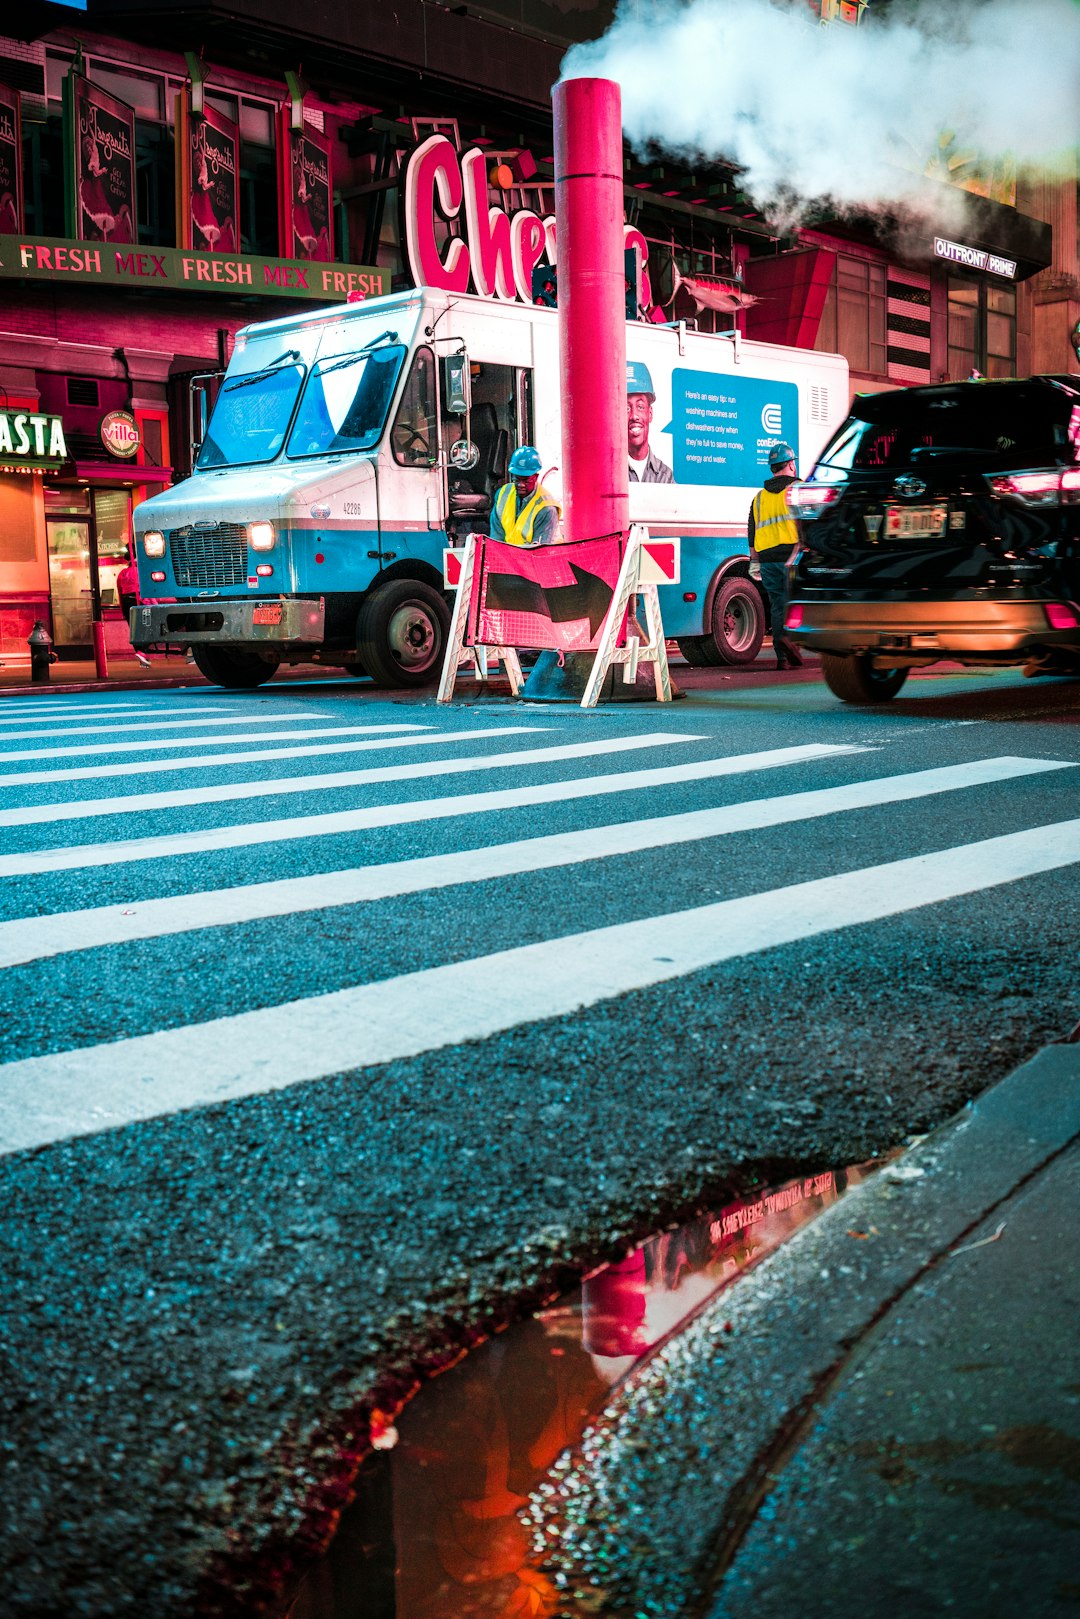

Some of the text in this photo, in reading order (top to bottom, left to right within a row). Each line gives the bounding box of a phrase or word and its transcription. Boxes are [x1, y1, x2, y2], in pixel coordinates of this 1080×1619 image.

[936, 240, 1014, 276] OUTFRONT PRIME
[20, 244, 101, 273] FRESH
[115, 252, 168, 278] MEX
[182, 258, 253, 285] FRESH
[264, 265, 310, 289] MEX
[322, 271, 383, 295] FRESH
[708, 395, 719, 403] easy
[685, 407, 738, 419] washing machines and
[103, 423, 140, 442] villa
[685, 422, 739, 434] dishwashers only when
[710, 440, 716, 448] to
[685, 454, 703, 463] energy
[703, 455, 713, 463] and
[343, 502, 362, 516] 42286
